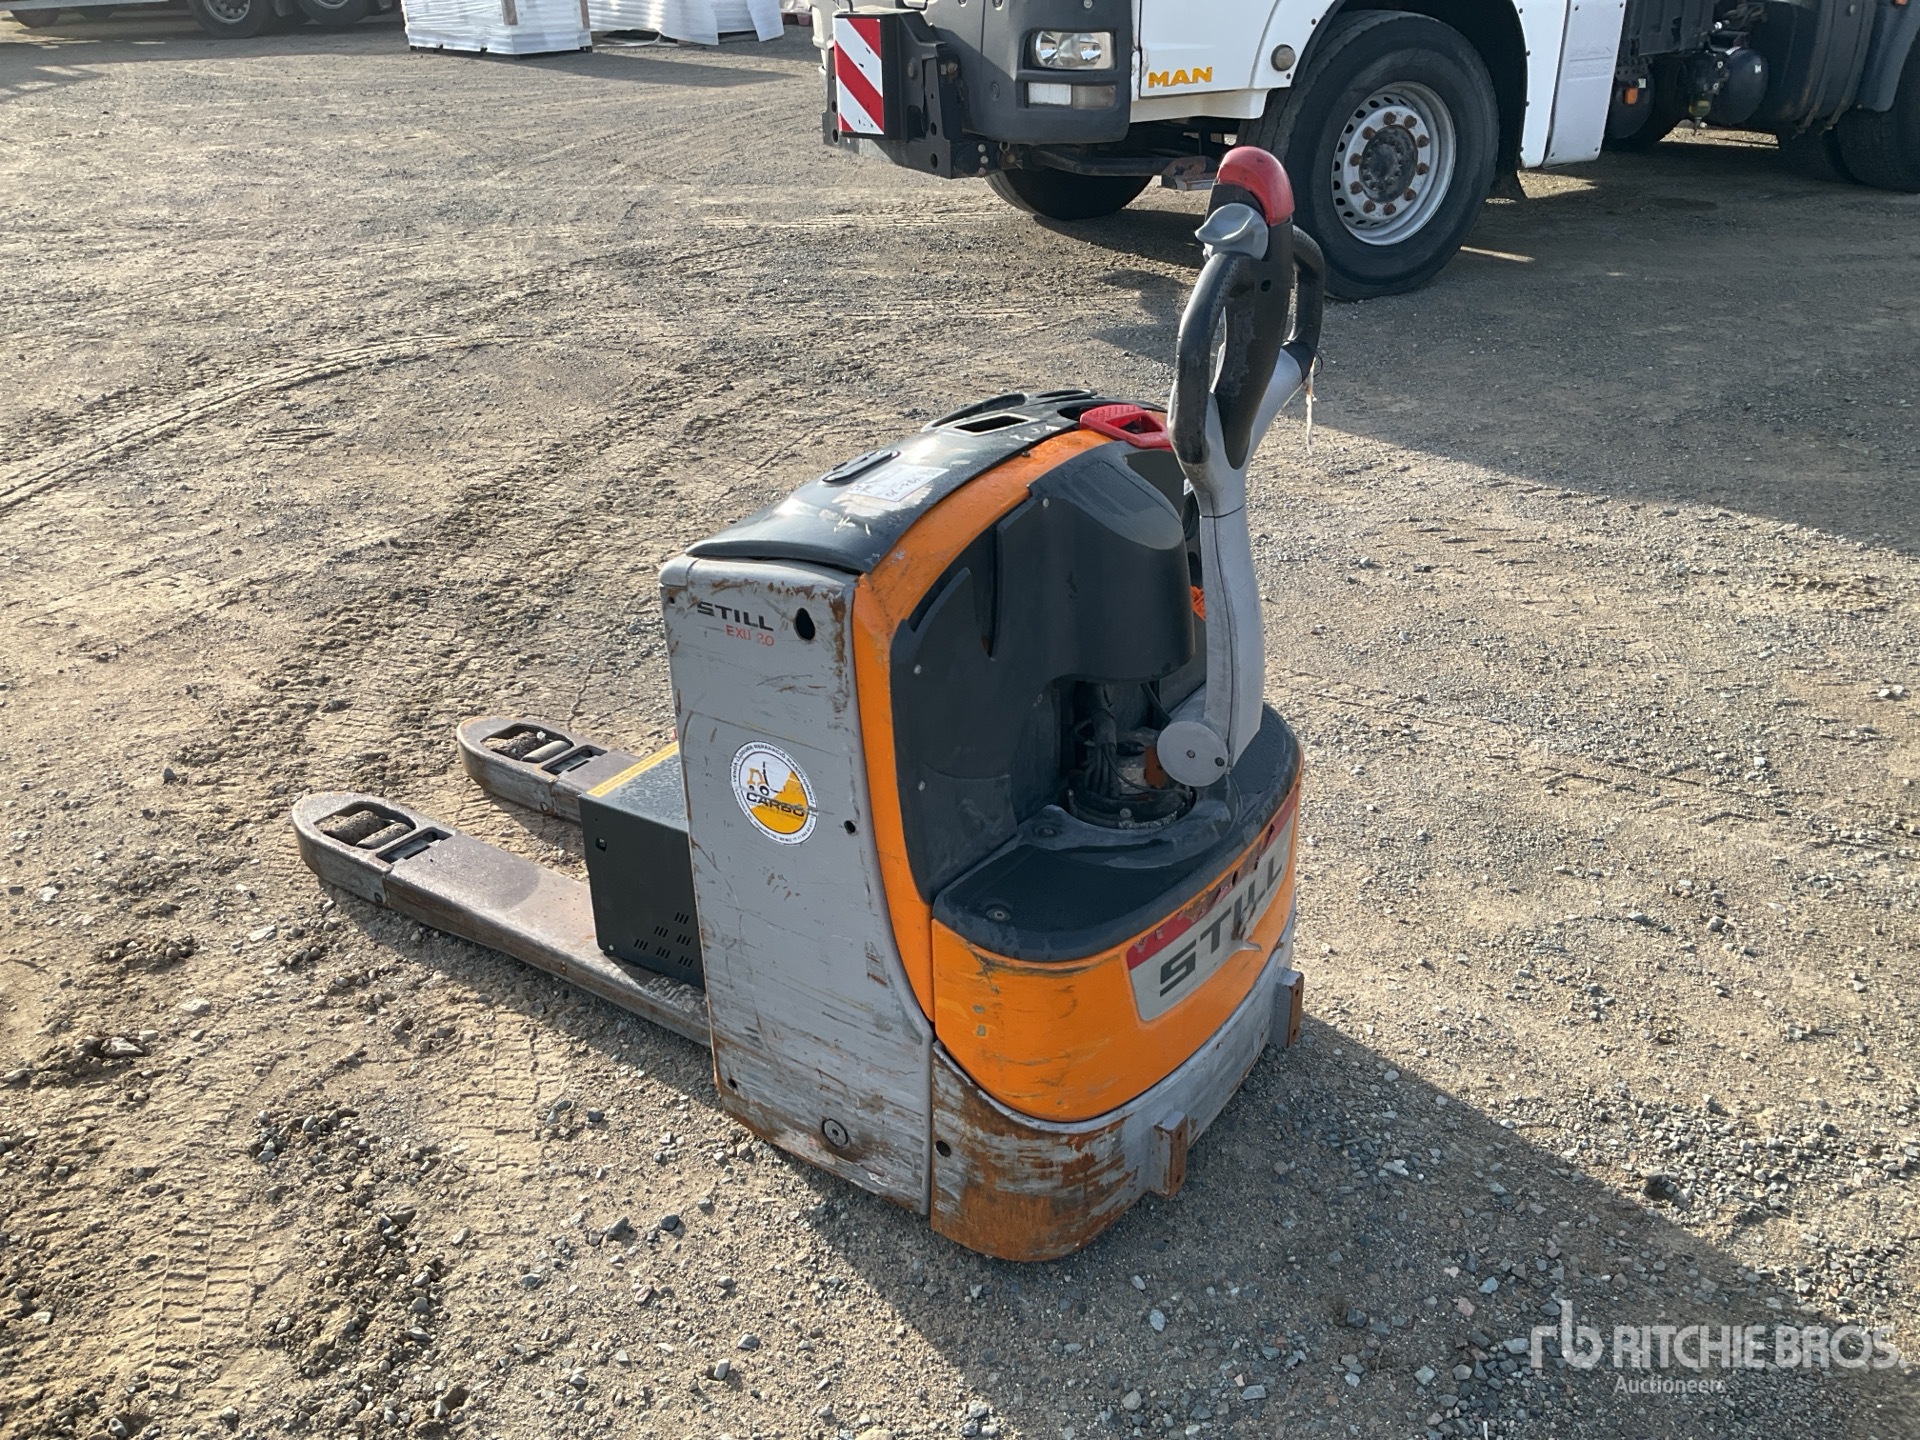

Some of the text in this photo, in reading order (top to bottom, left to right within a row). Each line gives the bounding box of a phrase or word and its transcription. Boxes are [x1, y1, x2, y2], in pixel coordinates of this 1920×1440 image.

[1148, 66, 1212, 88] MAN
[697, 601, 774, 632] STILL
[726, 624, 752, 641] EXU
[1160, 856, 1283, 998] STILL
